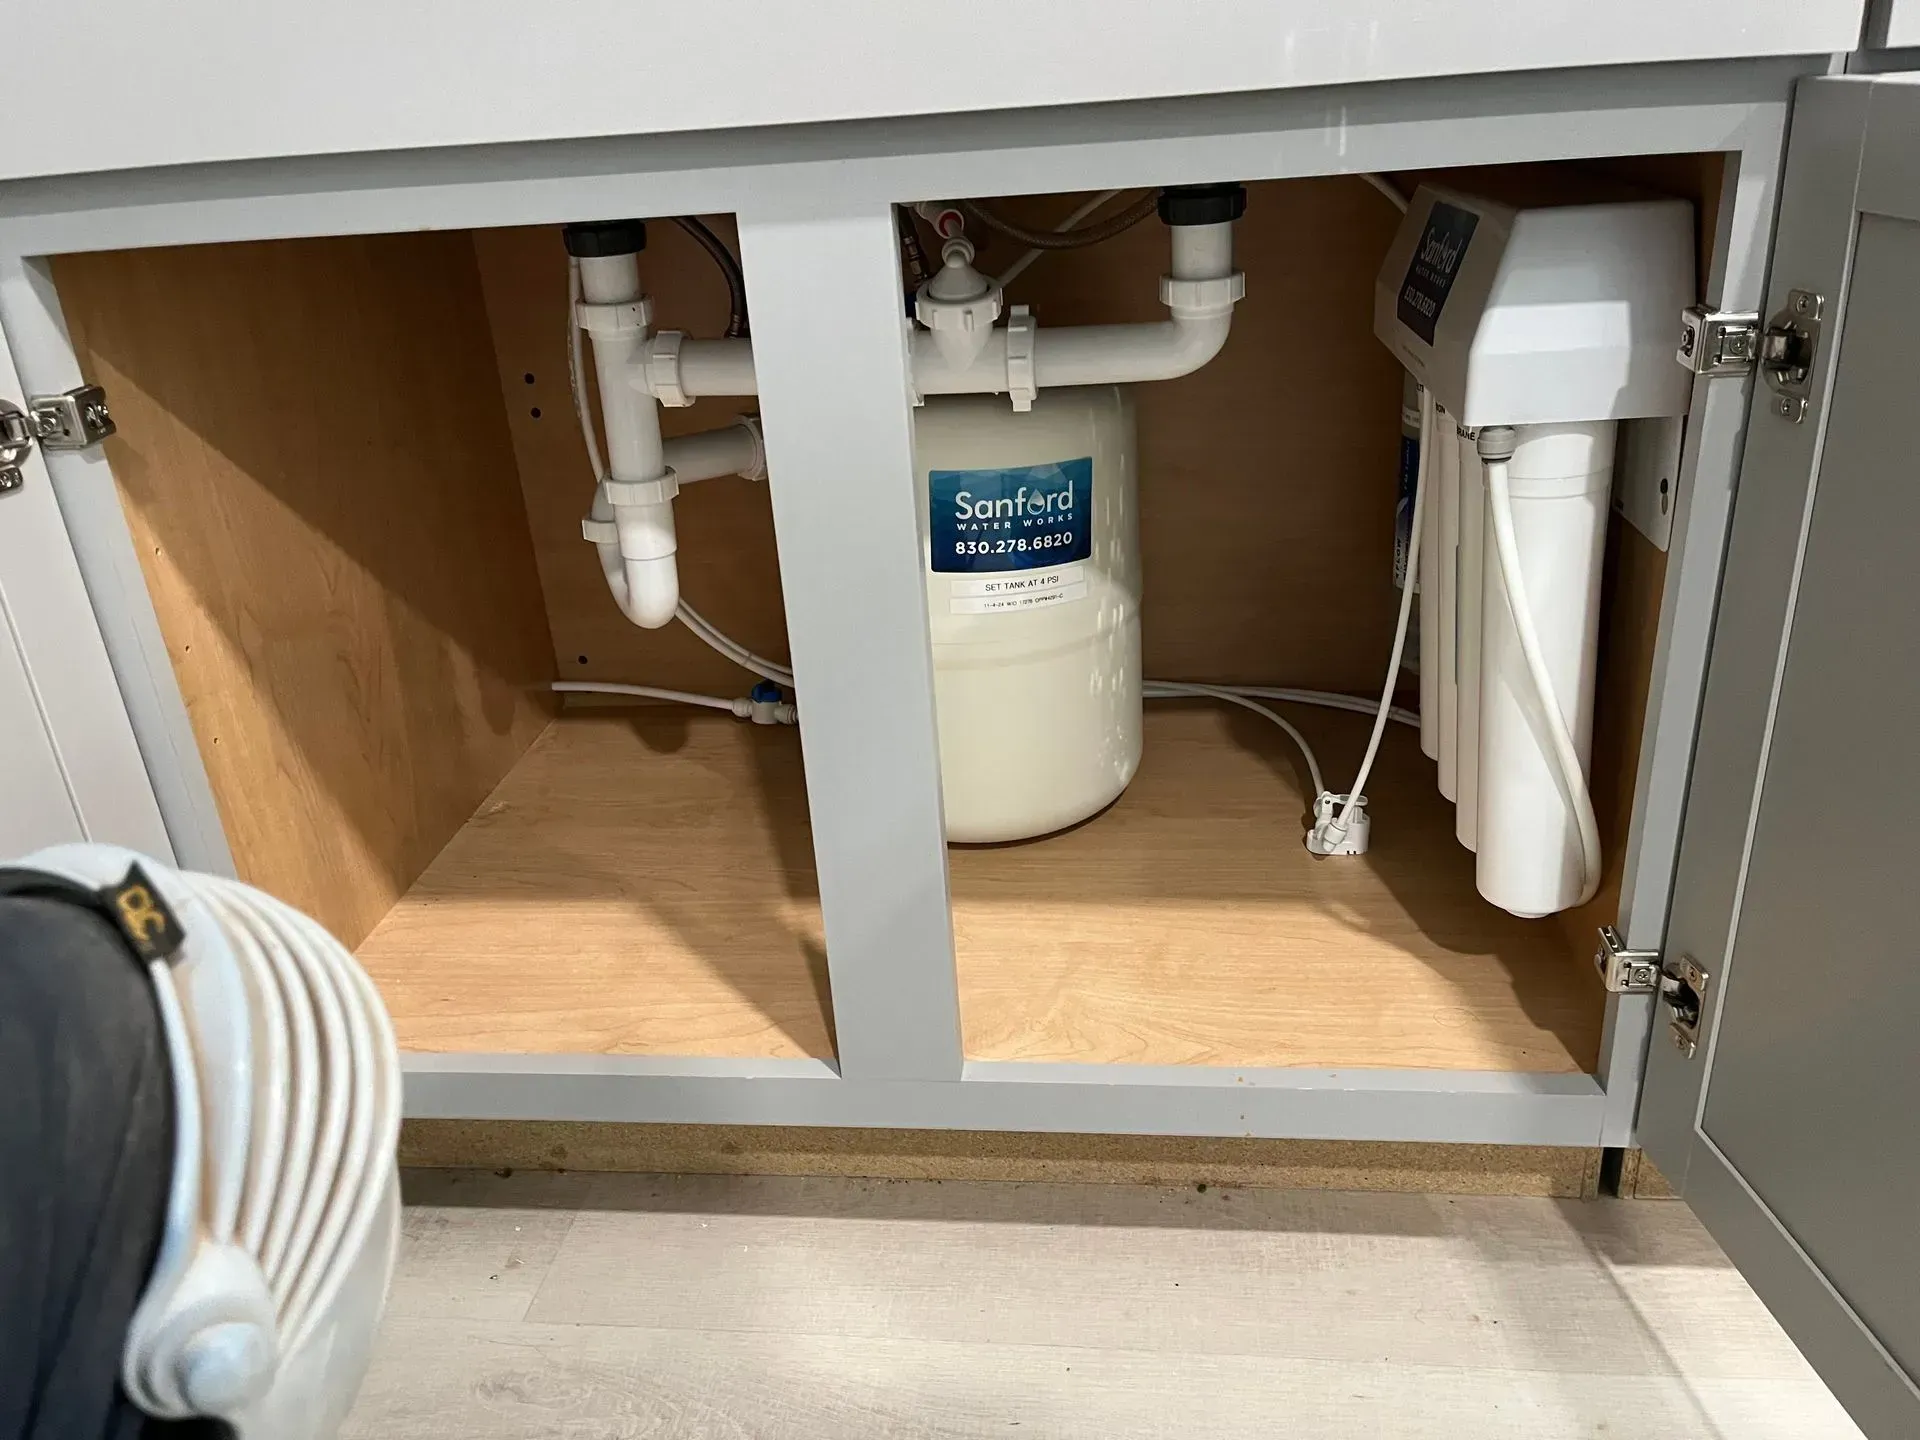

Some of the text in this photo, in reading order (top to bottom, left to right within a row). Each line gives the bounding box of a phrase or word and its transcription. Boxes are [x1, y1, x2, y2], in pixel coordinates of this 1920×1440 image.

[1420, 226, 1464, 274] Sanford
[955, 480, 1073, 520] Sanford
[956, 513, 1073, 531] WATER WORKS
[955, 531, 1073, 555] 830.278.6820
[985, 584, 1001, 592] SET
[1004, 581, 1026, 590] TANK
[1028, 579, 1038, 587] AT
[1047, 575, 1060, 584] PSI
